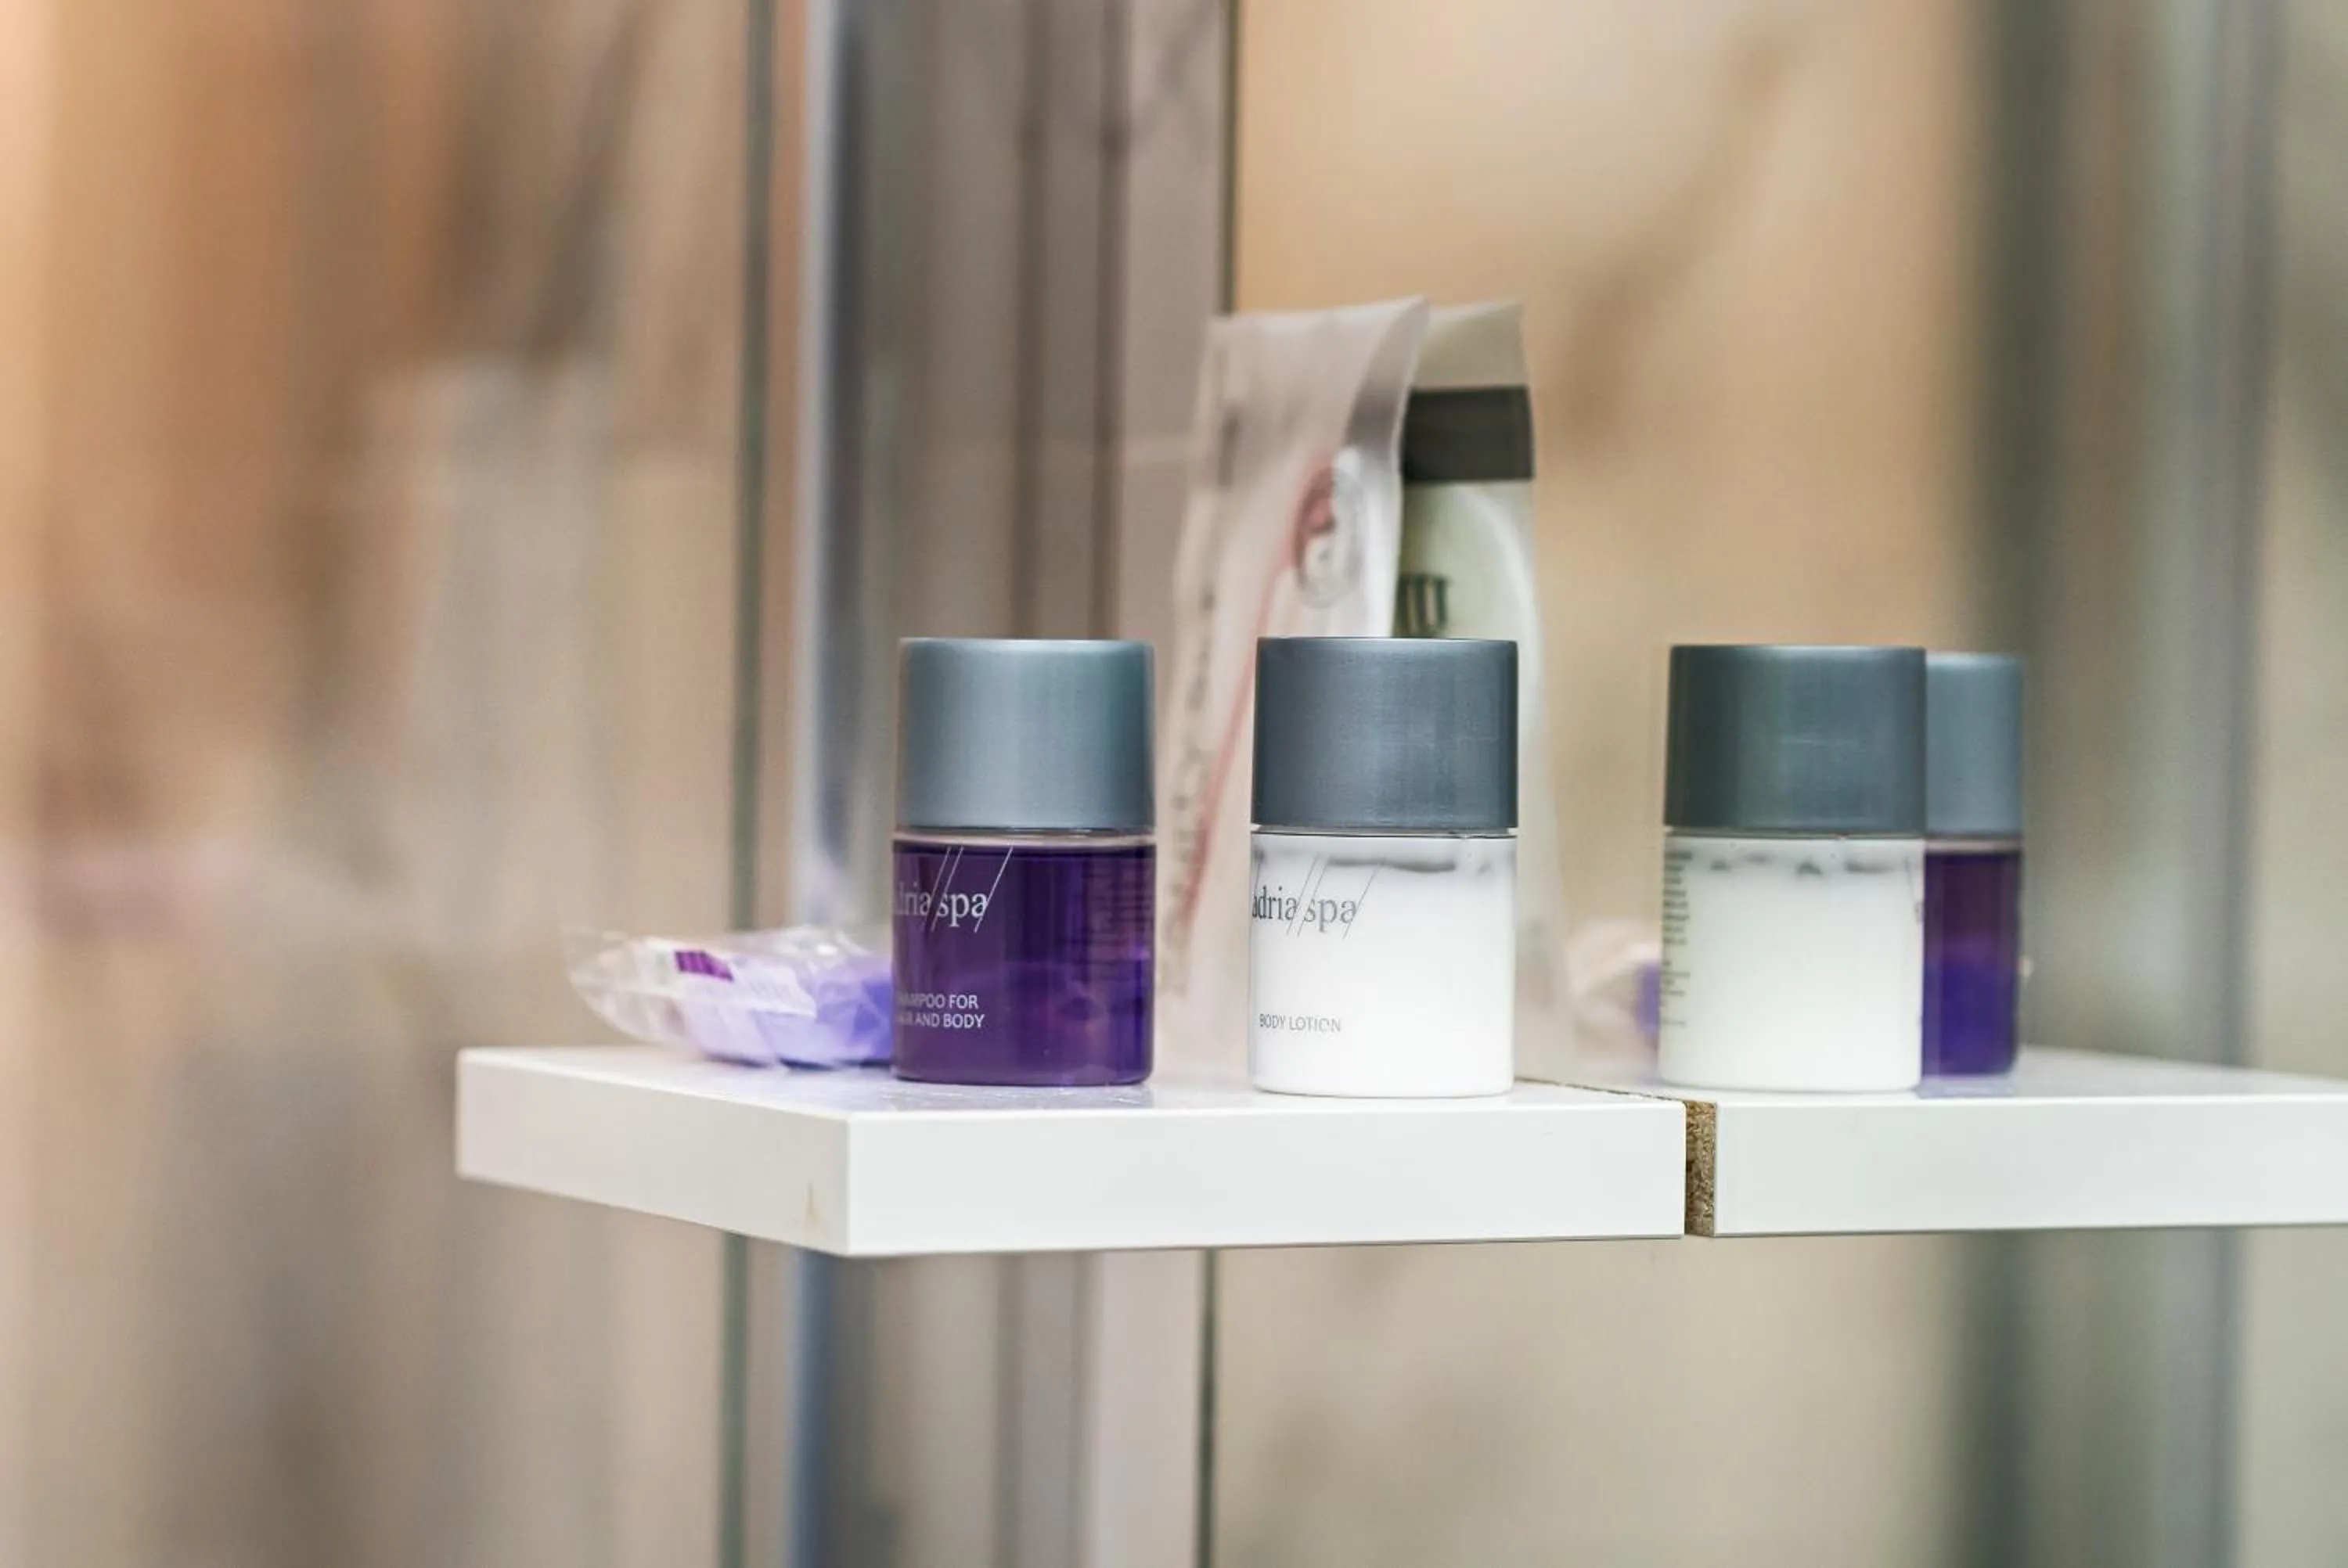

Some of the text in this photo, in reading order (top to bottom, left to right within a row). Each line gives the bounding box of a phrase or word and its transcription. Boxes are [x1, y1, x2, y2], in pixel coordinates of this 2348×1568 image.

[937, 892, 989, 927] spa
[1303, 897, 1357, 933] spa
[949, 994, 979, 1010] FOR
[914, 1012, 940, 1027] AND
[942, 1012, 985, 1029] BODY
[1259, 1013, 1341, 1033] BODY LOTION
